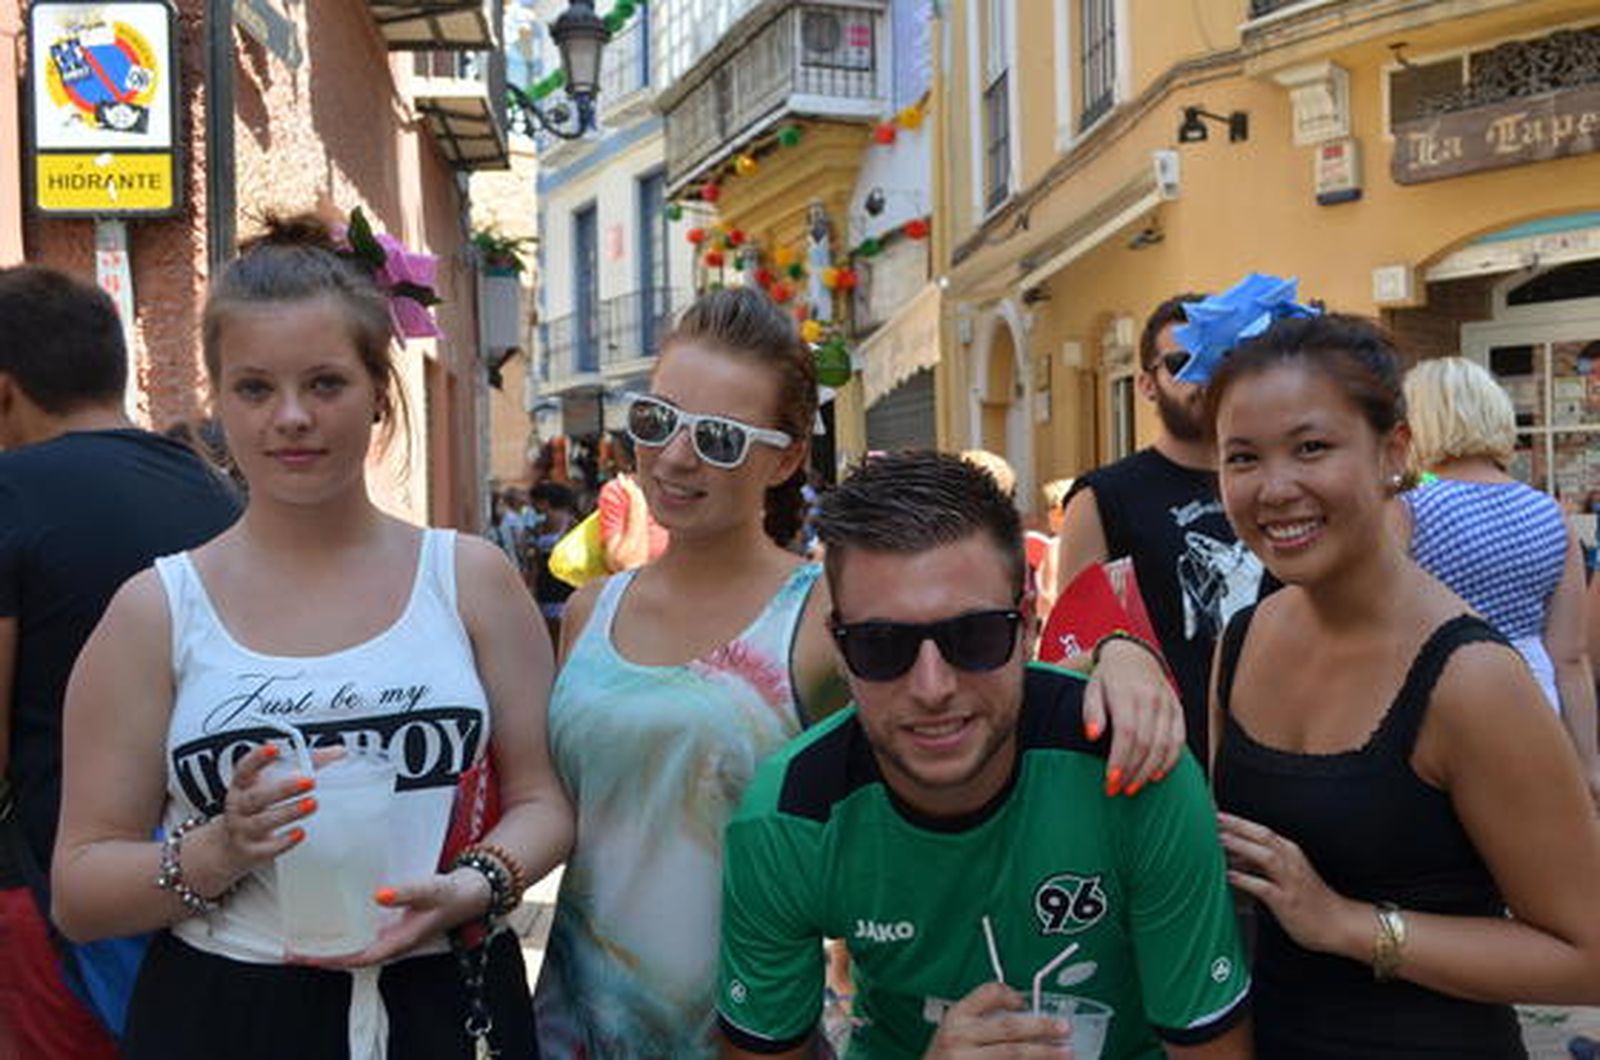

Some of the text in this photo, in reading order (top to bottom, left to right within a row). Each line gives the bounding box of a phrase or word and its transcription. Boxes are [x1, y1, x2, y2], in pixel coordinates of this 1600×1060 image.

[48, 173, 162, 190] HIDRANTE
[202, 671, 428, 735] Just be my
[1037, 875, 1106, 934] 96
[855, 919, 915, 942] JAKO
